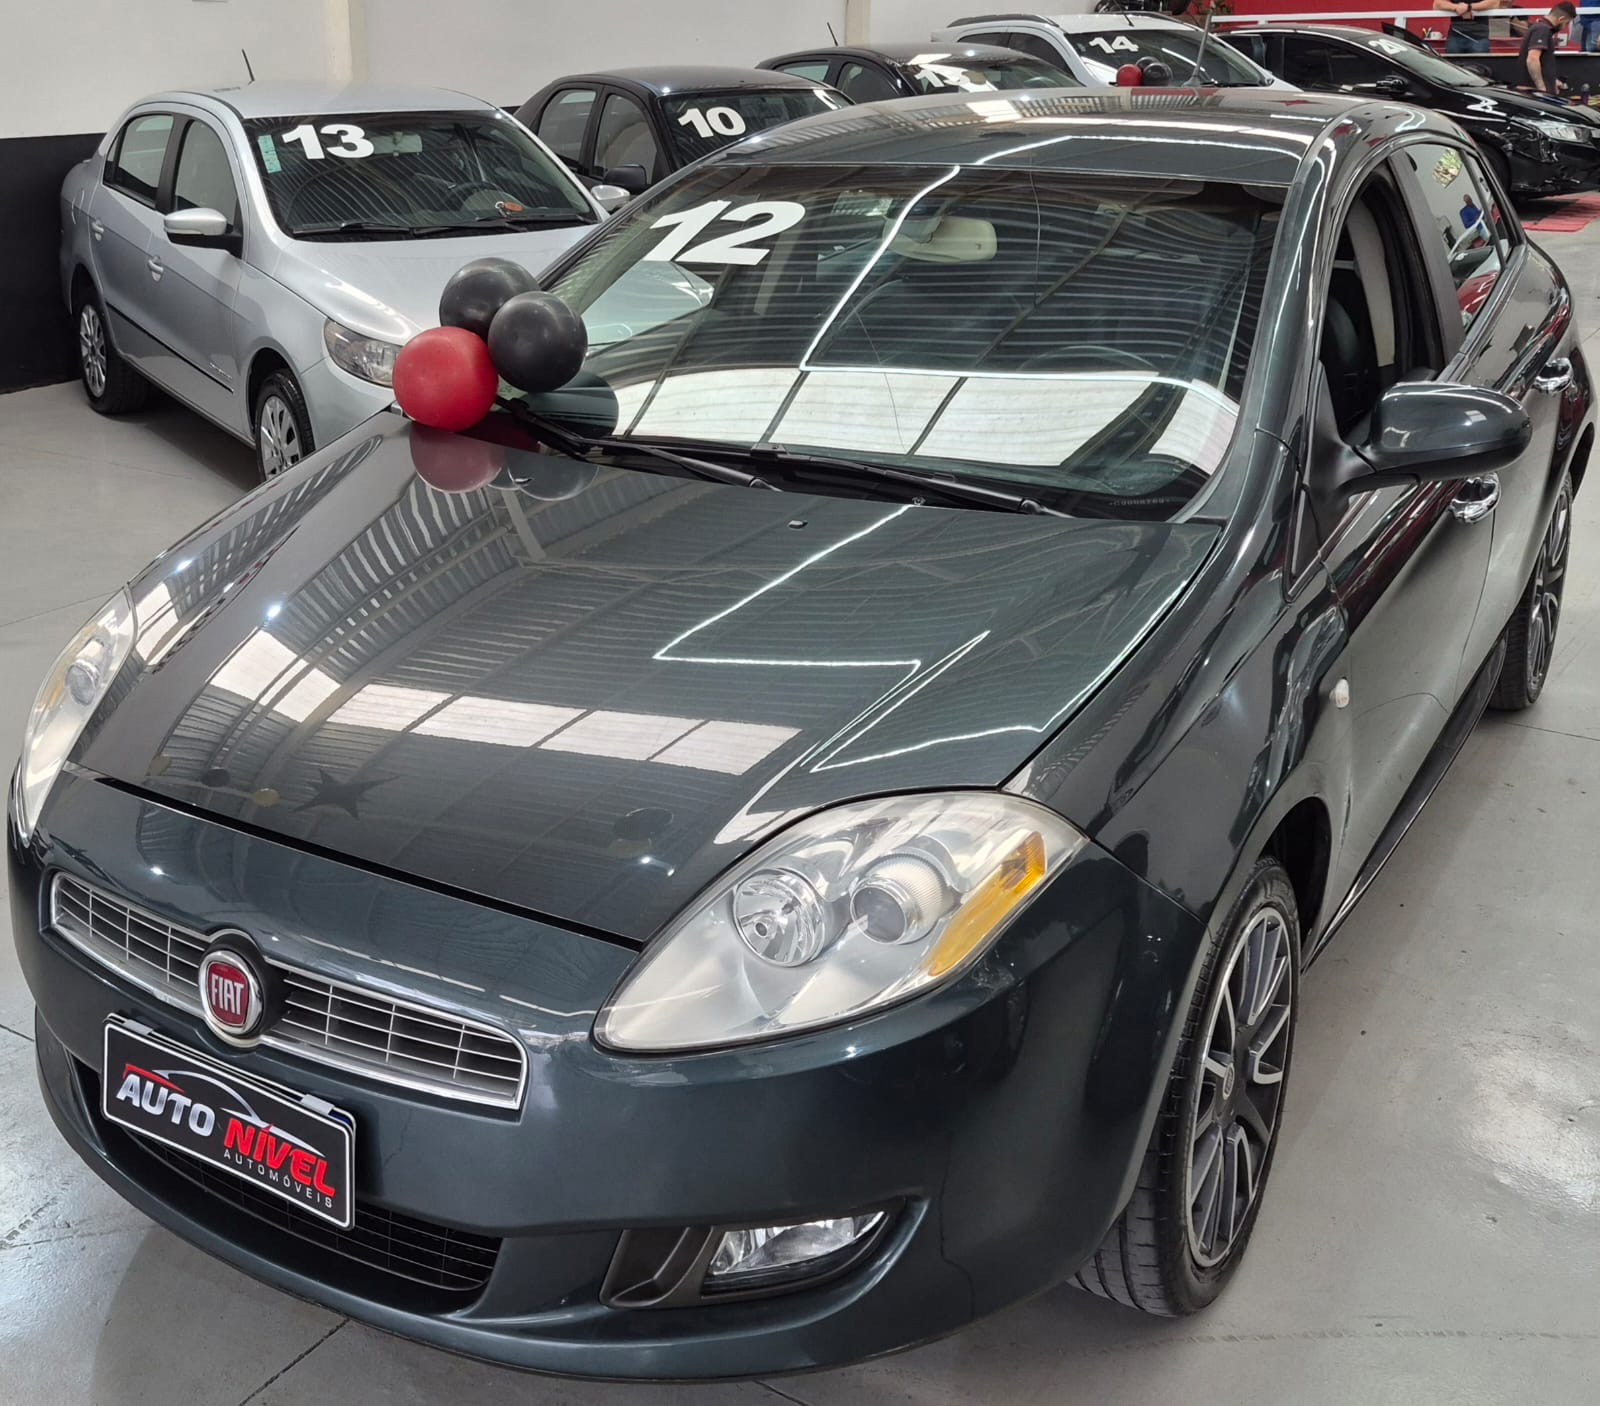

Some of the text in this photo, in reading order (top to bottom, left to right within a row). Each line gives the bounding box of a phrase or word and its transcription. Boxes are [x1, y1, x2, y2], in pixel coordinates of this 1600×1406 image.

[1089, 36, 1139, 54] 14
[281, 124, 375, 160] 13
[677, 106, 747, 138] 10
[641, 199, 806, 266] 12
[210, 973, 245, 1016] FIAT
[115, 1073, 336, 1197] AUTO NÍVEL
[222, 1148, 333, 1209] AUTOMÓVEIS
